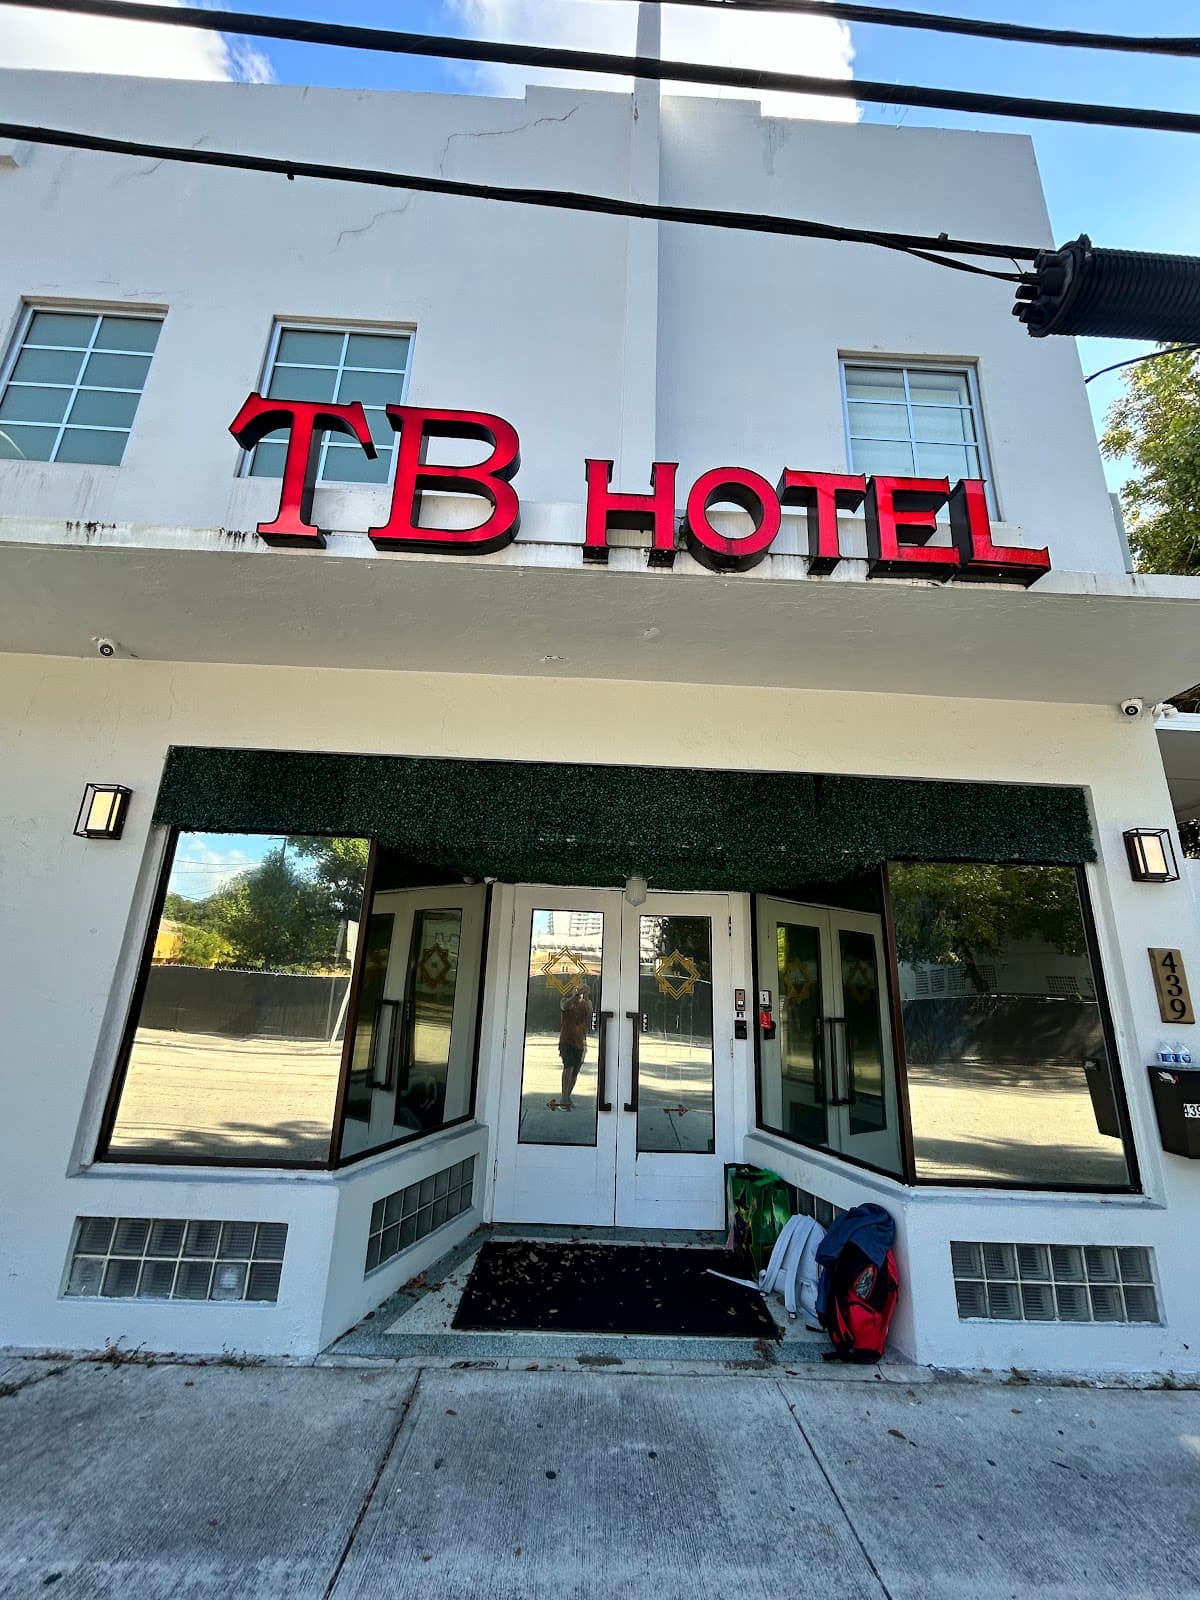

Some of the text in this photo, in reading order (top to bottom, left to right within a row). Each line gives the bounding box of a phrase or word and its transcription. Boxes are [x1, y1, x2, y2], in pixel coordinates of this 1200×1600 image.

[228, 391, 1051, 588] TB HOTEL
[1161, 952, 1187, 1020] 439
